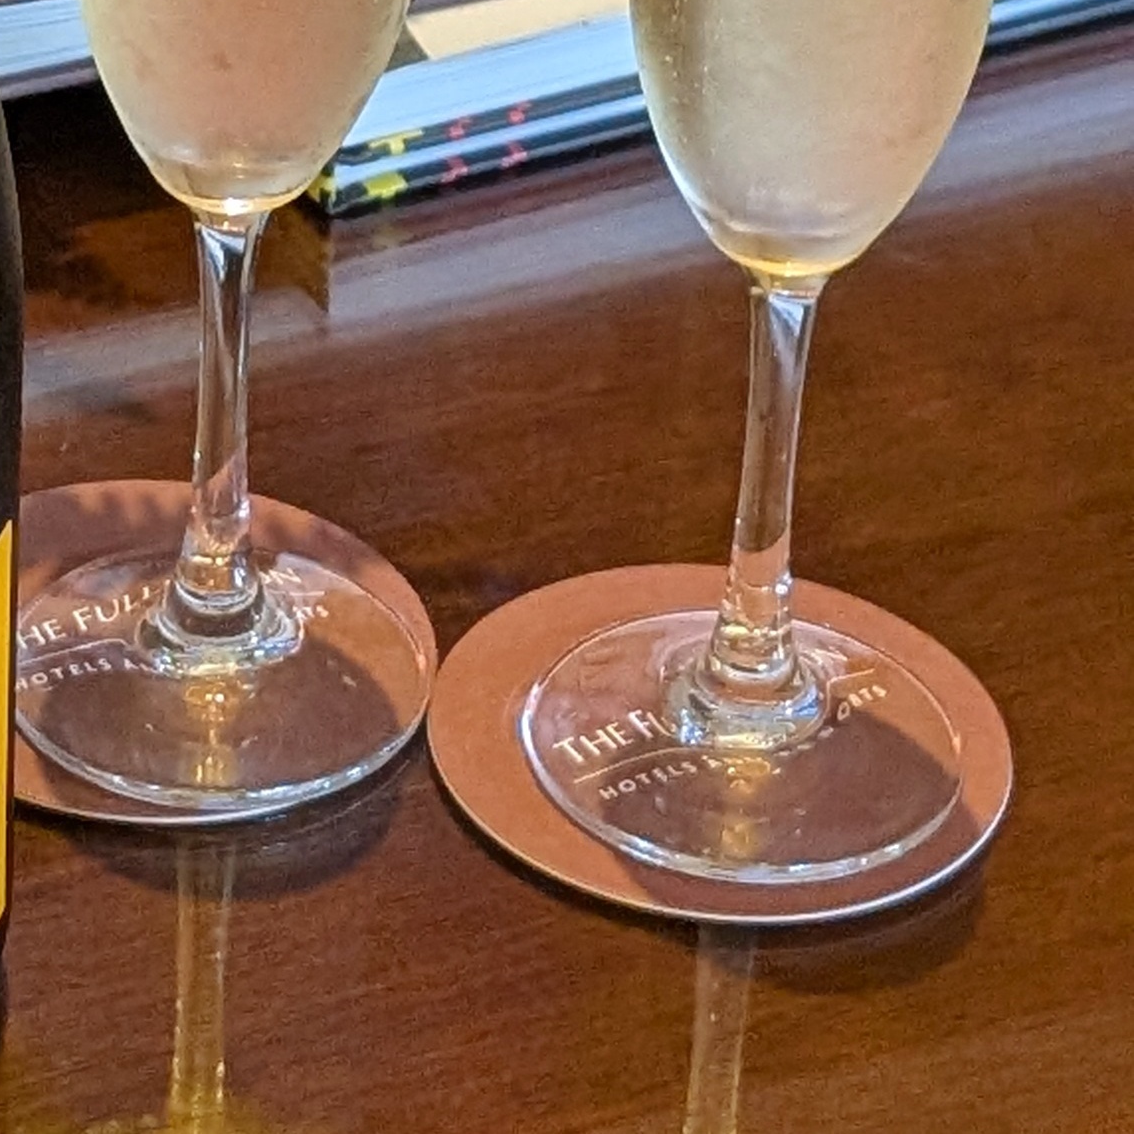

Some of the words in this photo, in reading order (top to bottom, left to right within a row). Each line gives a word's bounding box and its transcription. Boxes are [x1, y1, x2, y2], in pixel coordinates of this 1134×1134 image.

[16, 618, 67, 650] HE
[552, 721, 635, 764] THE
[599, 760, 699, 801] HOTELS
